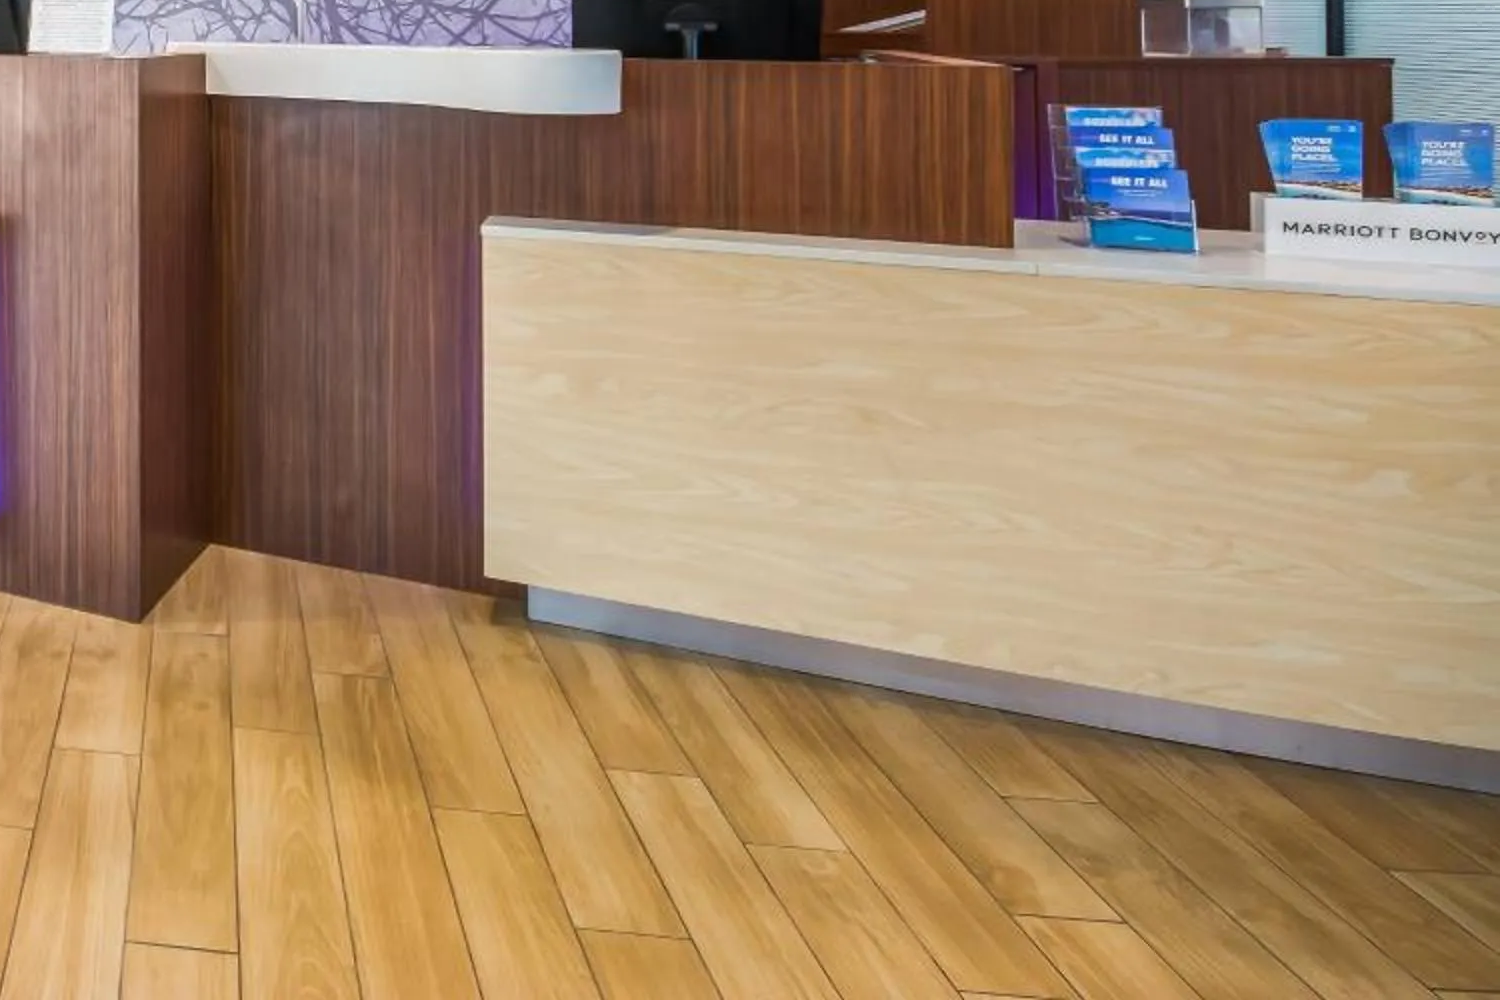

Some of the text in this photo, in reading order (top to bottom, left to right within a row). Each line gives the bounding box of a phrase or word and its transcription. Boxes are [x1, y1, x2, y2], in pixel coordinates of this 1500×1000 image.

[1121, 130, 1133, 143] IT
[1134, 176, 1146, 188] IT
[1282, 220, 1402, 240] MARRIOTT
